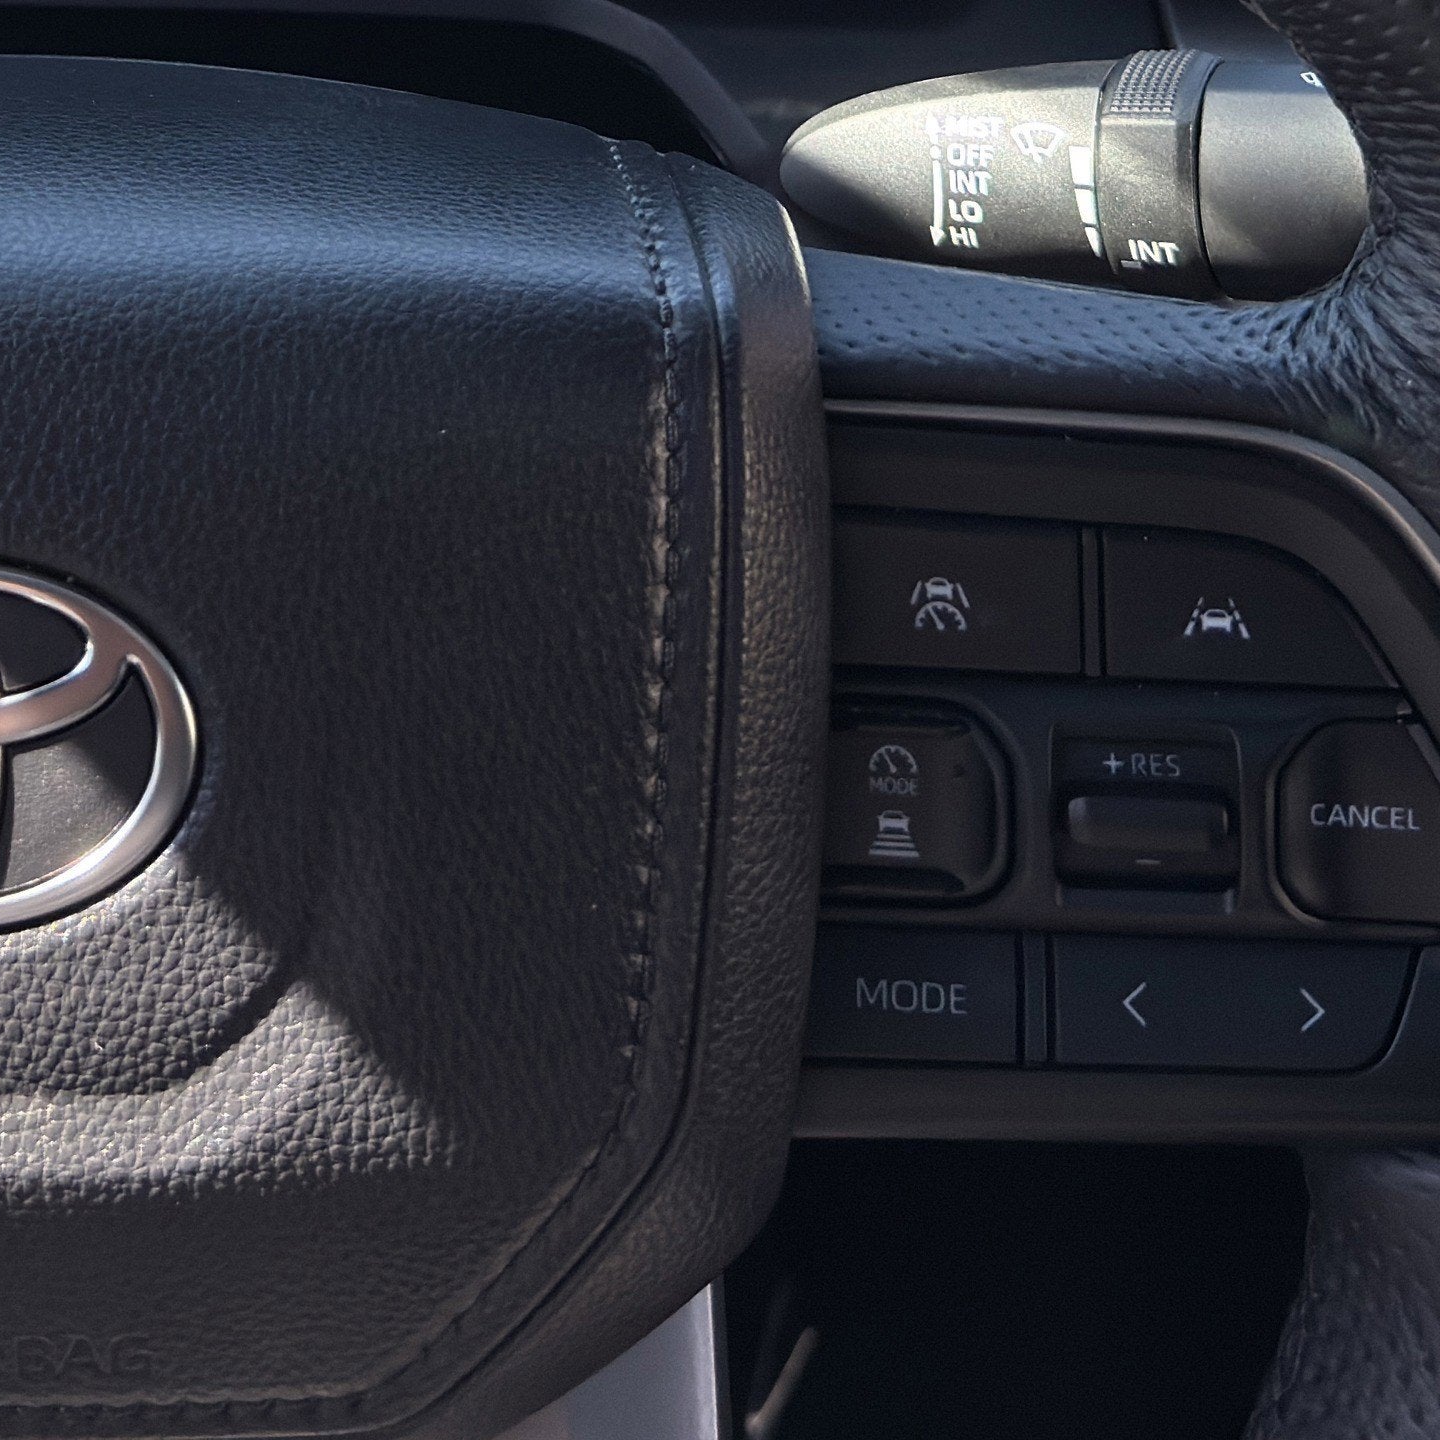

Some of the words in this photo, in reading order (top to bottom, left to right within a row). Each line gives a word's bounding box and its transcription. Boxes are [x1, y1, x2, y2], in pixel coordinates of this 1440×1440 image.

[947, 143, 995, 167] OFF
[949, 170, 993, 196] INT
[948, 198, 984, 223] LO
[948, 225, 979, 250] HI
[1129, 239, 1179, 266] INT
[868, 777, 918, 796] MODE
[1310, 802, 1420, 831] CANCEL
[855, 976, 968, 1015] MODE
